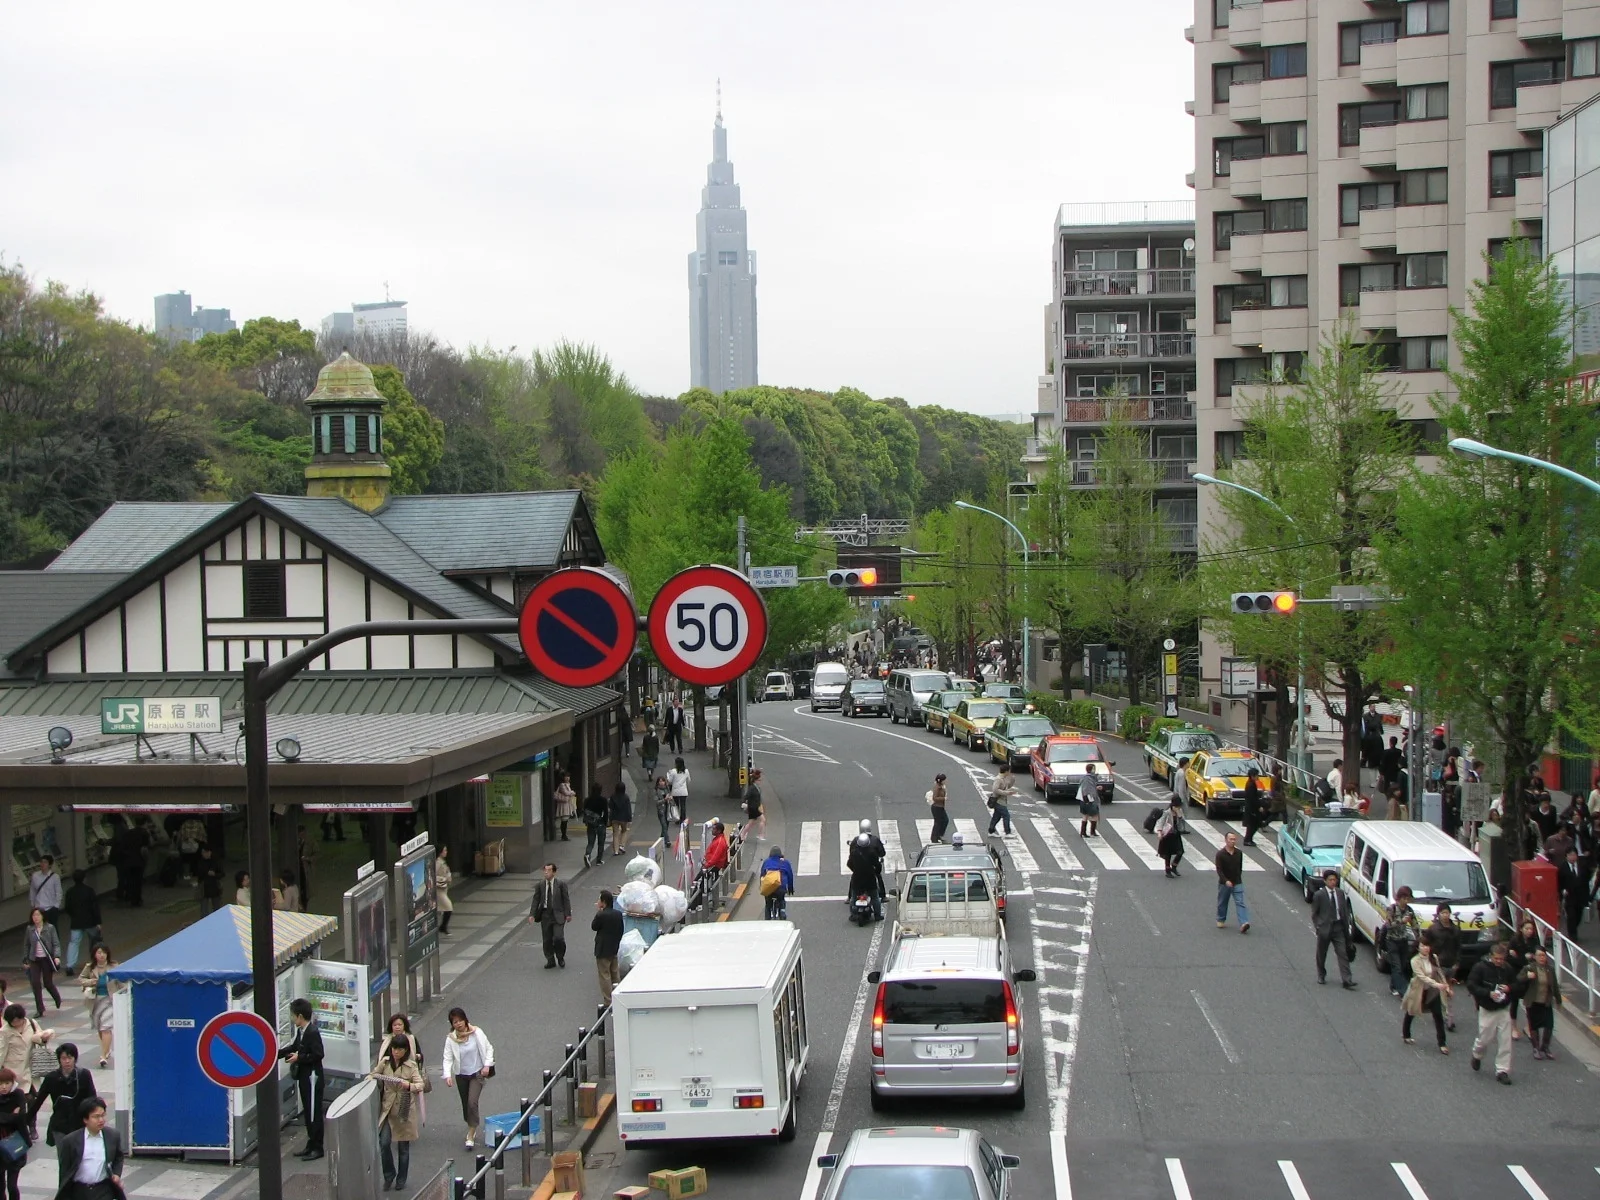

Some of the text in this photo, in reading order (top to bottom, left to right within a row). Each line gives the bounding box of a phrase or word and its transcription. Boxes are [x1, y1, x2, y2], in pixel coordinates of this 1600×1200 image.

[752, 568, 794, 579] 原宿駅前
[676, 602, 739, 652] 50
[106, 703, 140, 724] JR
[147, 703, 210, 719] 原宿駅
[147, 721, 217, 730] Harajuku Station
